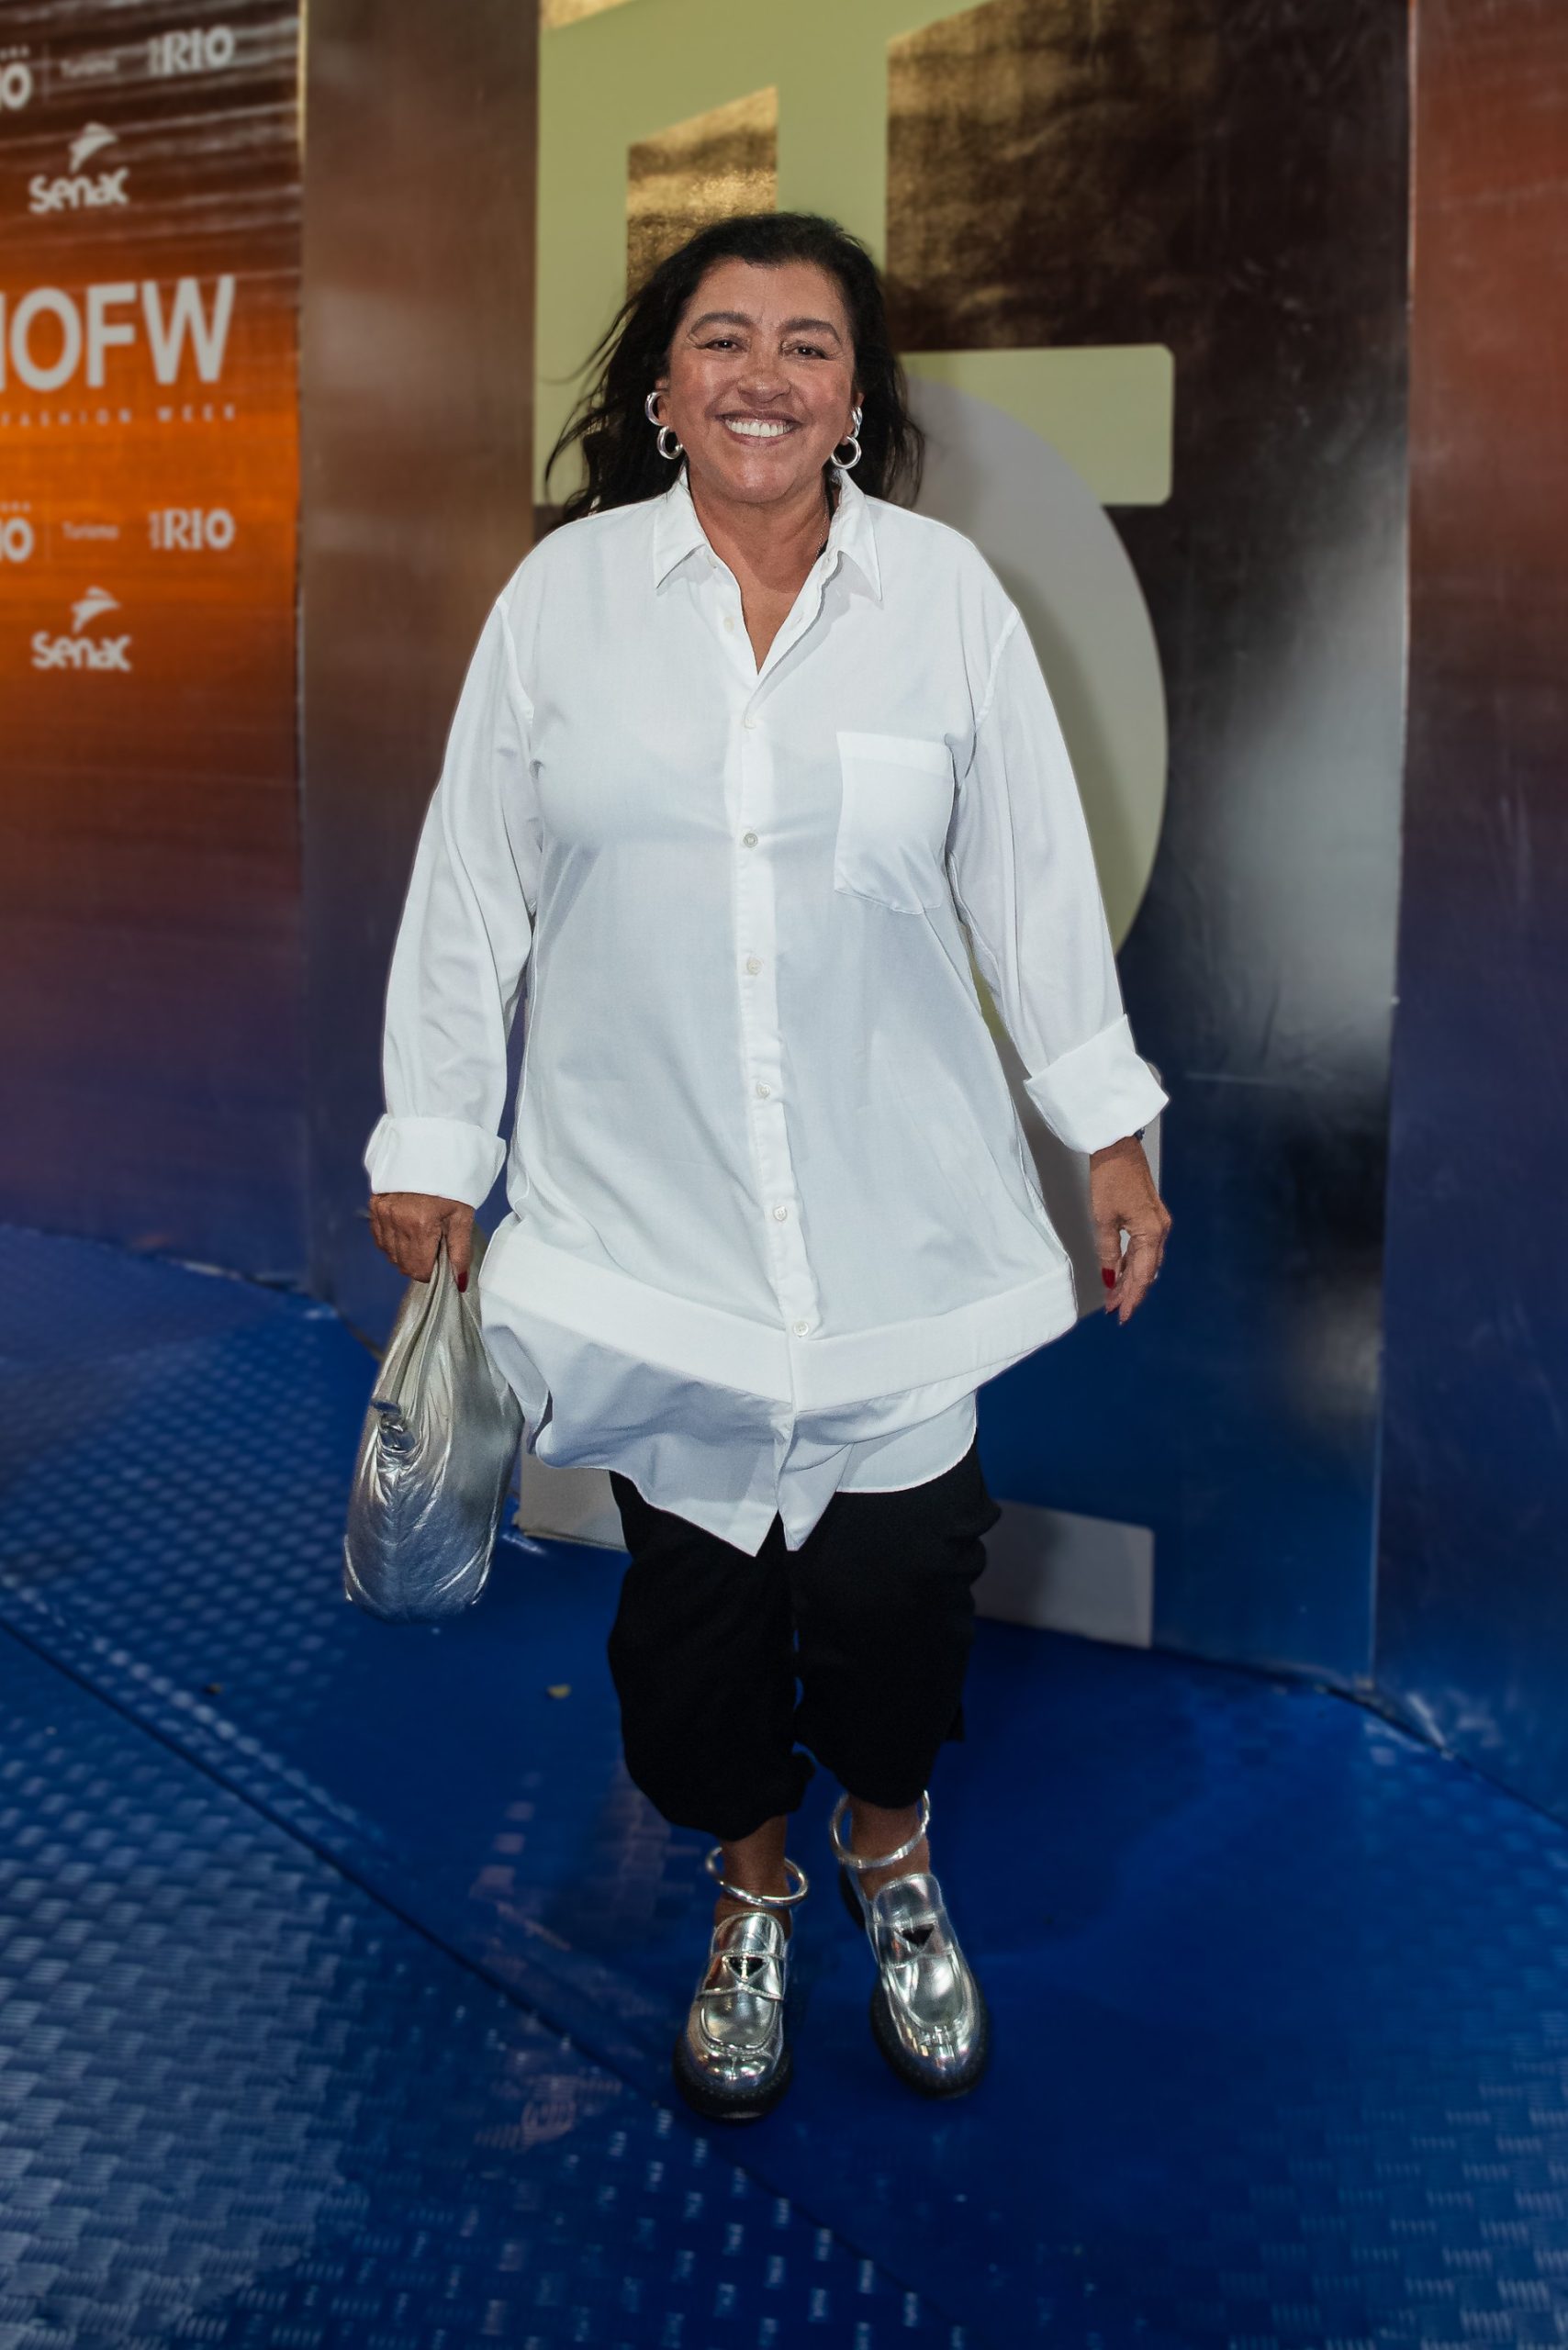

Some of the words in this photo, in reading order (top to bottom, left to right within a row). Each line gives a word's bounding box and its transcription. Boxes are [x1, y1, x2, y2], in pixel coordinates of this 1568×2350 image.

[162, 26, 234, 76] RIO
[0, 274, 236, 392] OFW
[158, 403, 235, 423] WEEK
[163, 508, 235, 550] RIO
